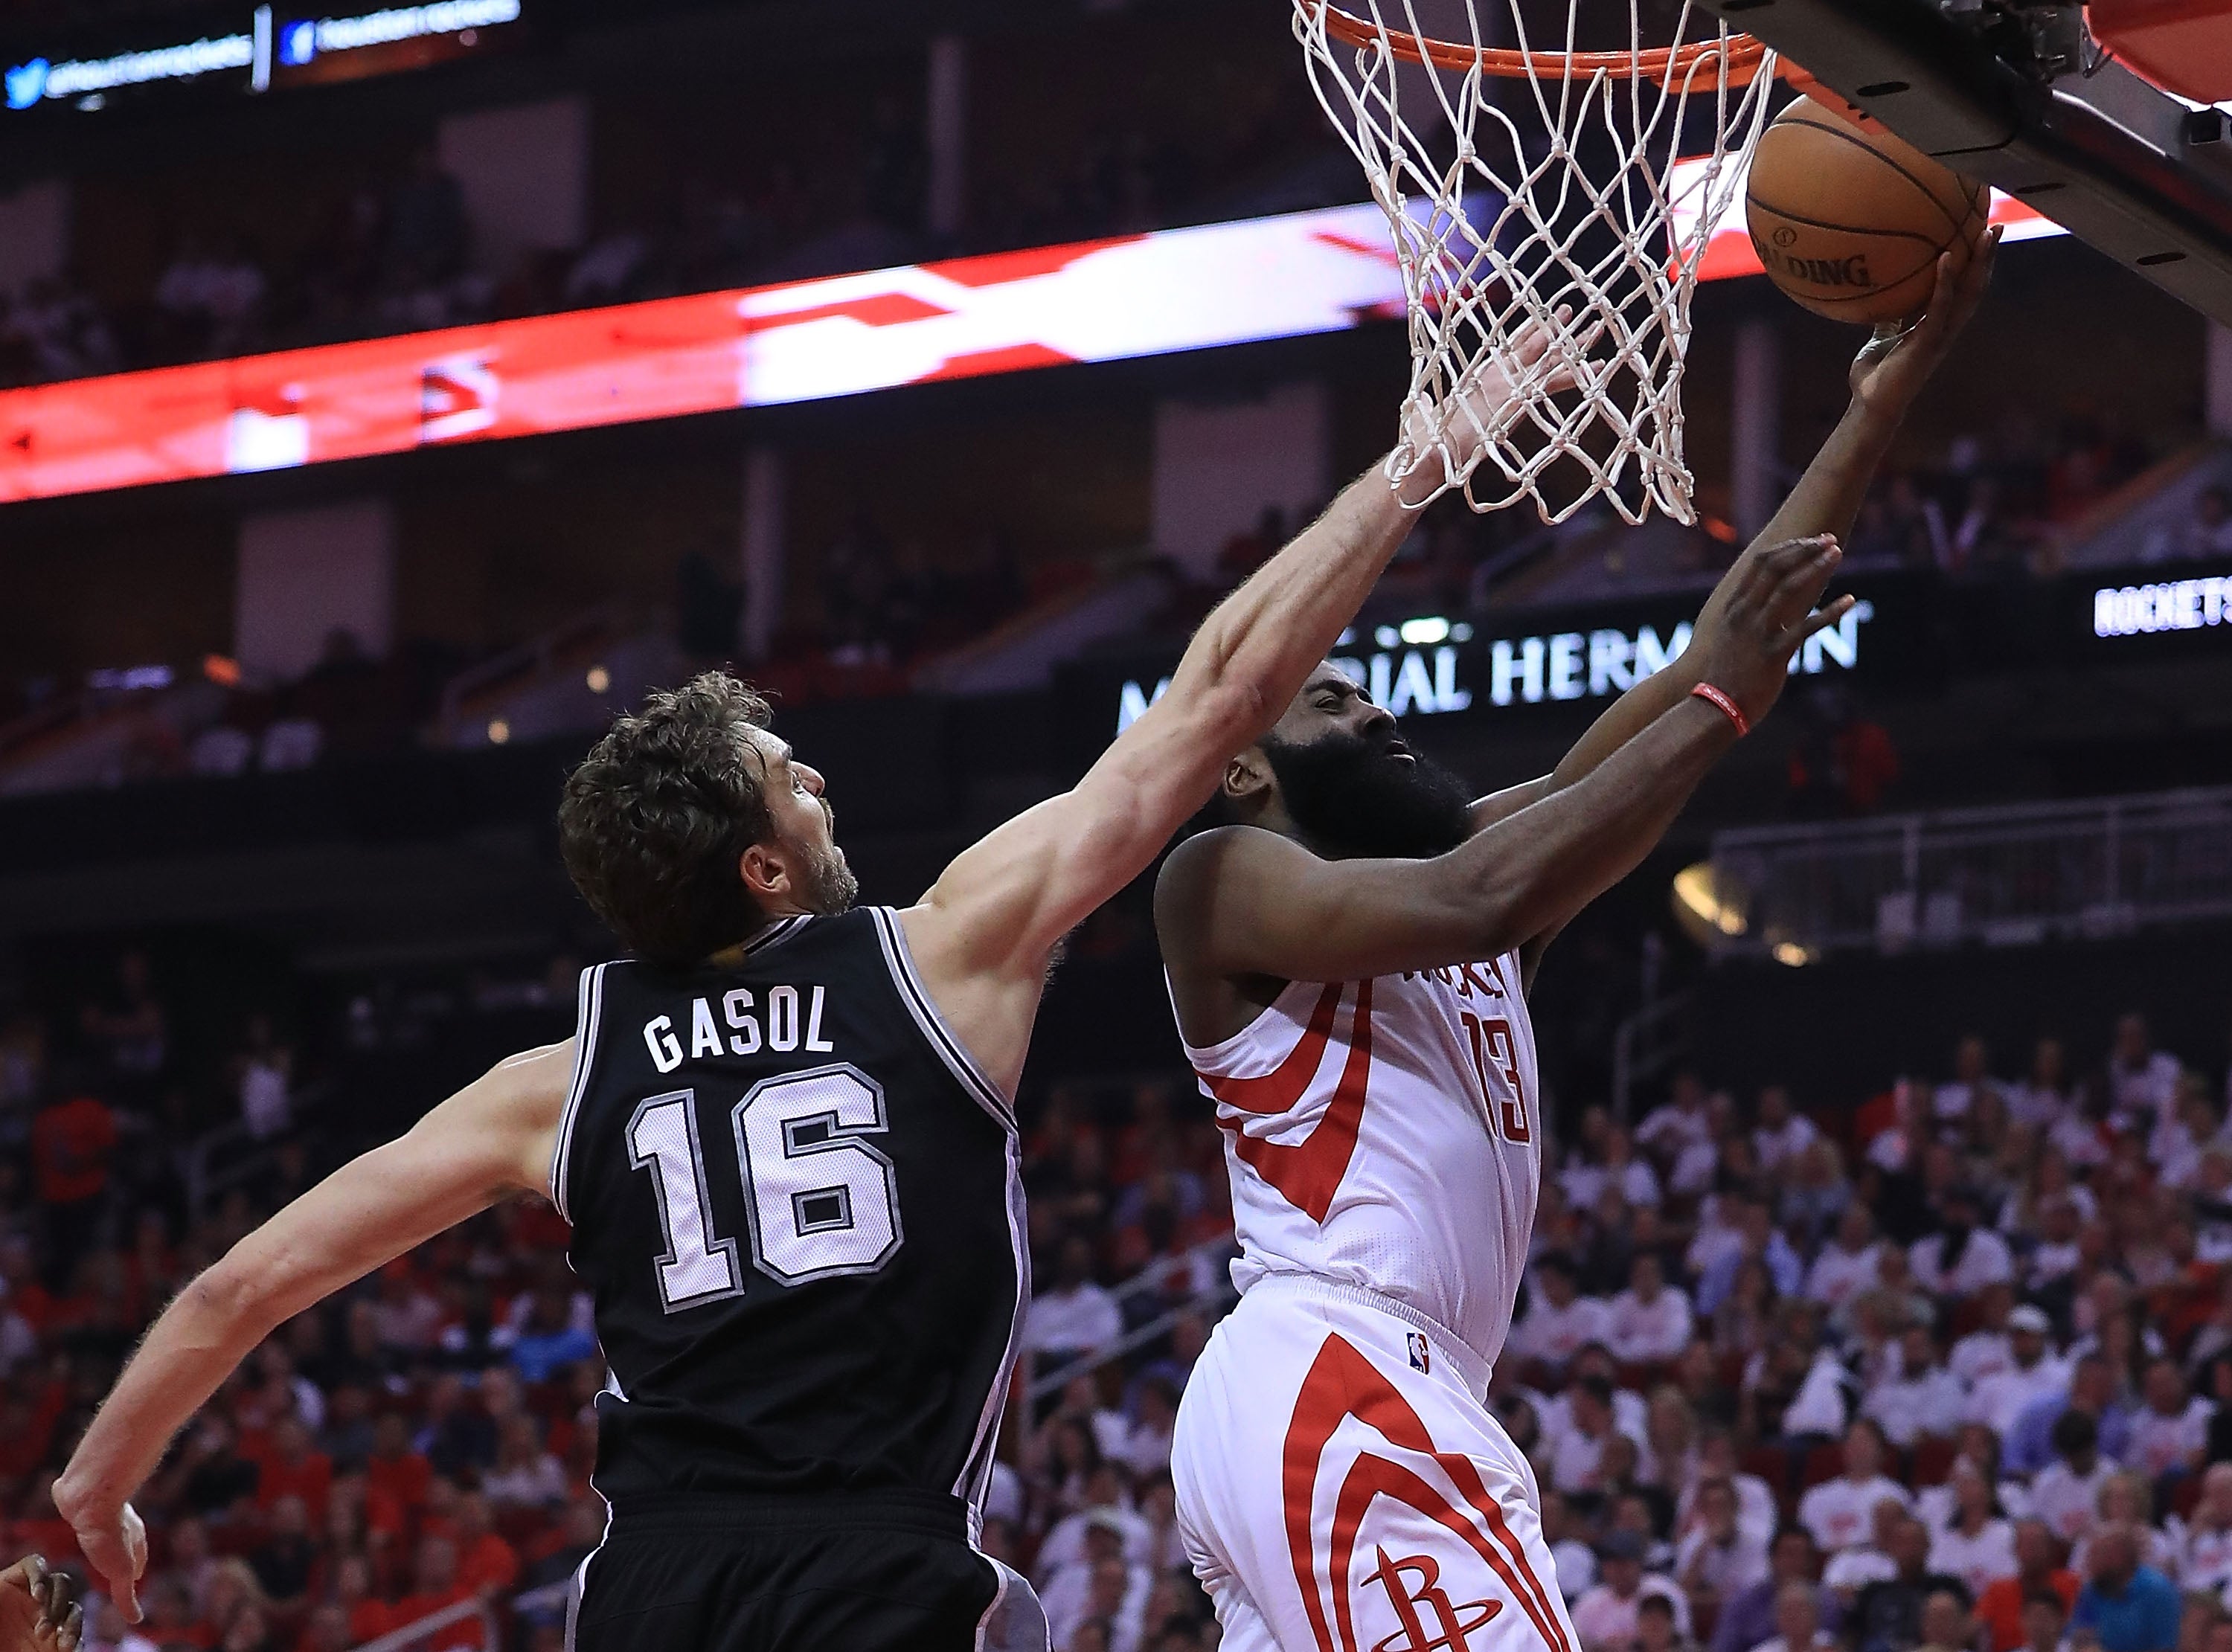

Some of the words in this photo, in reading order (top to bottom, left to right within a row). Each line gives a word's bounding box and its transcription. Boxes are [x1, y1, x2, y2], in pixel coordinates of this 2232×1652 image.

[1759, 243, 1870, 287] DING
[1117, 644, 1473, 736] MIAL
[1490, 607, 1860, 707] HERMN
[643, 986, 834, 1073] GASOL
[1459, 1009, 1531, 1146] 13
[625, 1061, 905, 1315] 16
